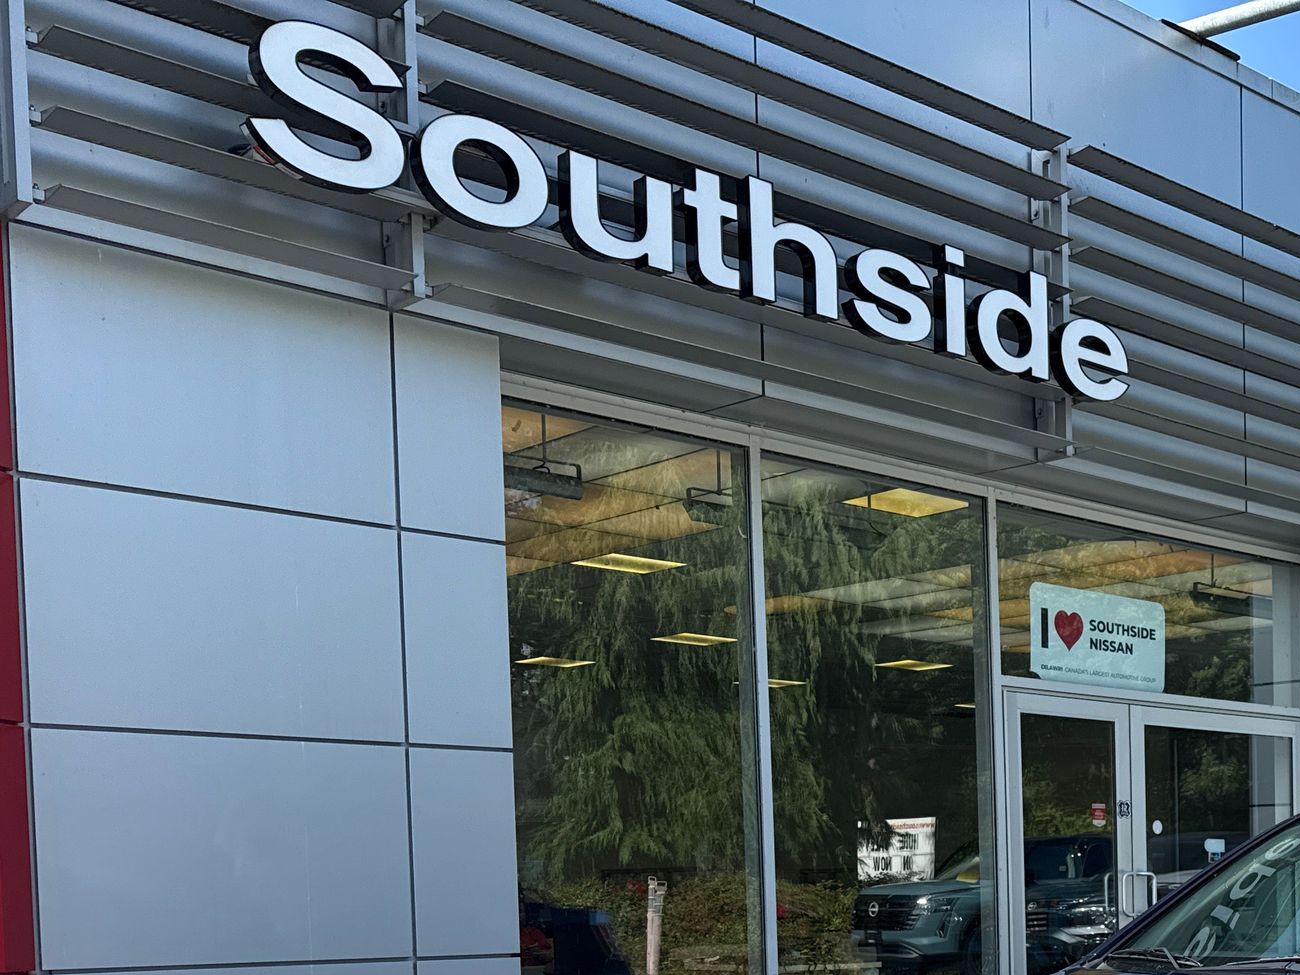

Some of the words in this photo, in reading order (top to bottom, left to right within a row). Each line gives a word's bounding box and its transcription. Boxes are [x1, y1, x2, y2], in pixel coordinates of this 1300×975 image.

[250, 19, 1130, 402] Southside
[1040, 607, 1049, 649] I
[1089, 619, 1156, 640] SOUTHSIDE
[1089, 637, 1134, 655] NISSAN
